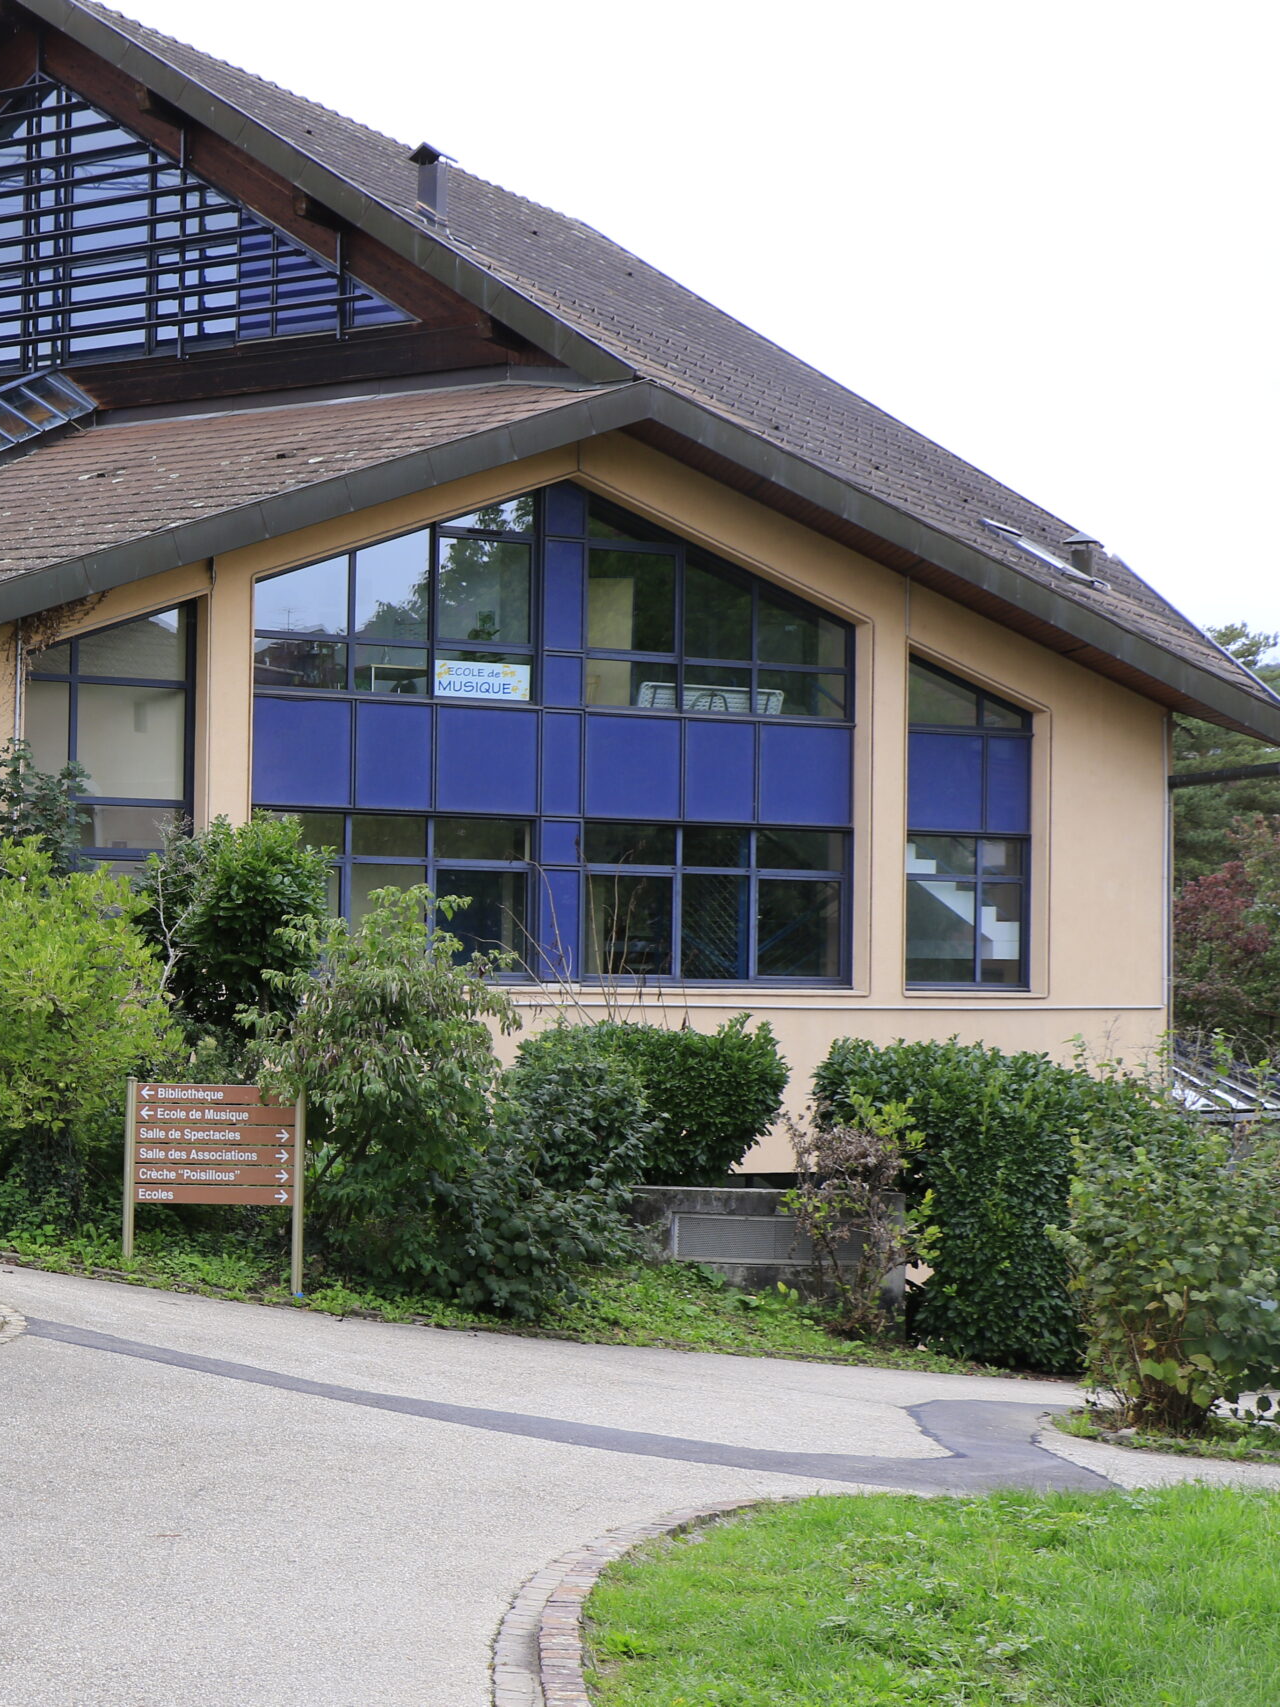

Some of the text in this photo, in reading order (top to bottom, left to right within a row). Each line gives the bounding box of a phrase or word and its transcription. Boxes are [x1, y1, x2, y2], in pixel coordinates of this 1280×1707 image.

[448, 667, 501, 678] ECOLE de
[438, 680, 511, 695] MUSIQUE
[157, 1088, 224, 1101] Bibliothèque
[157, 1108, 249, 1122] Ecole de Musique
[139, 1128, 241, 1141] Salle de Spectacles
[139, 1148, 258, 1161] Salle des Associations
[139, 1168, 176, 1180] Crèche
[138, 1188, 174, 1199] Ecoles
